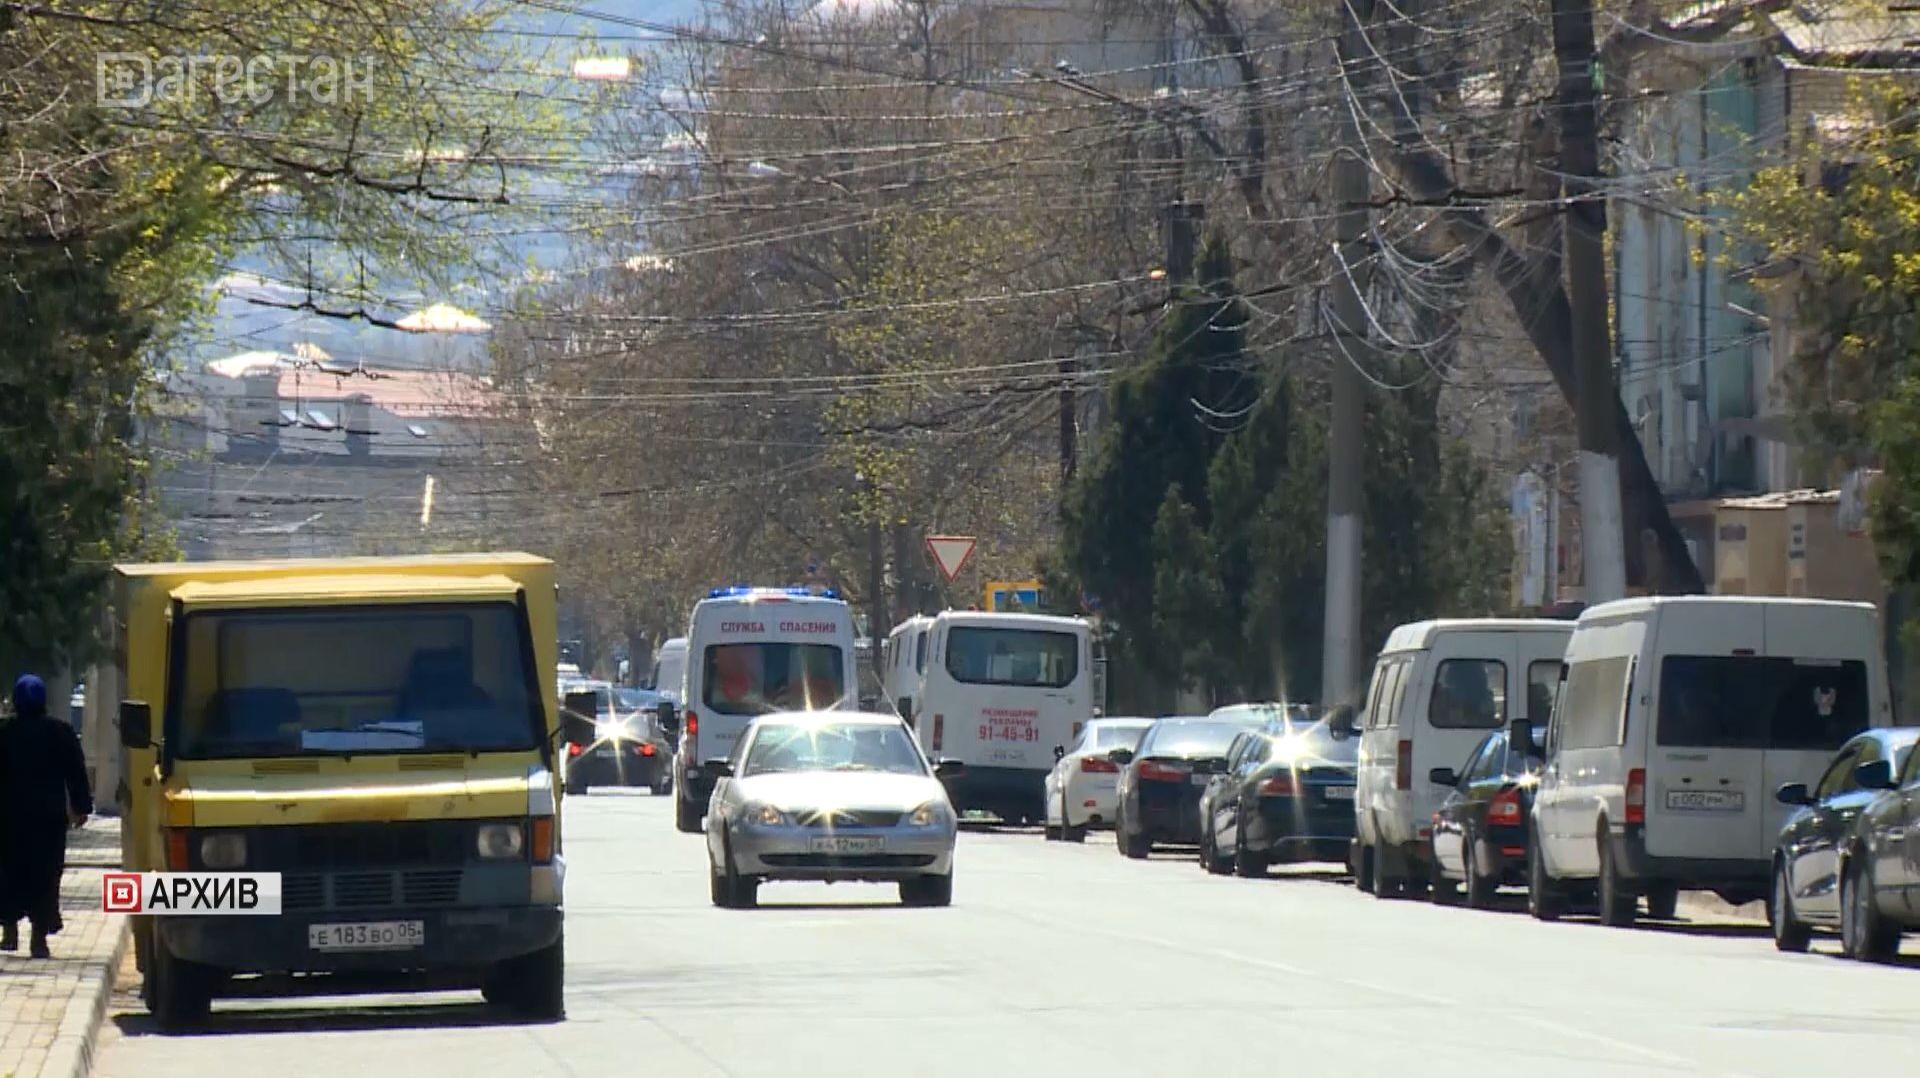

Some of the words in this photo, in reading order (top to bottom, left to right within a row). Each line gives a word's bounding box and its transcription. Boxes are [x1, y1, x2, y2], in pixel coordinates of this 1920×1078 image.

[720, 622, 765, 633] СЛУЖБА
[779, 621, 837, 633] СПАСЕНИЯ
[978, 725, 1039, 741] 91-45-91
